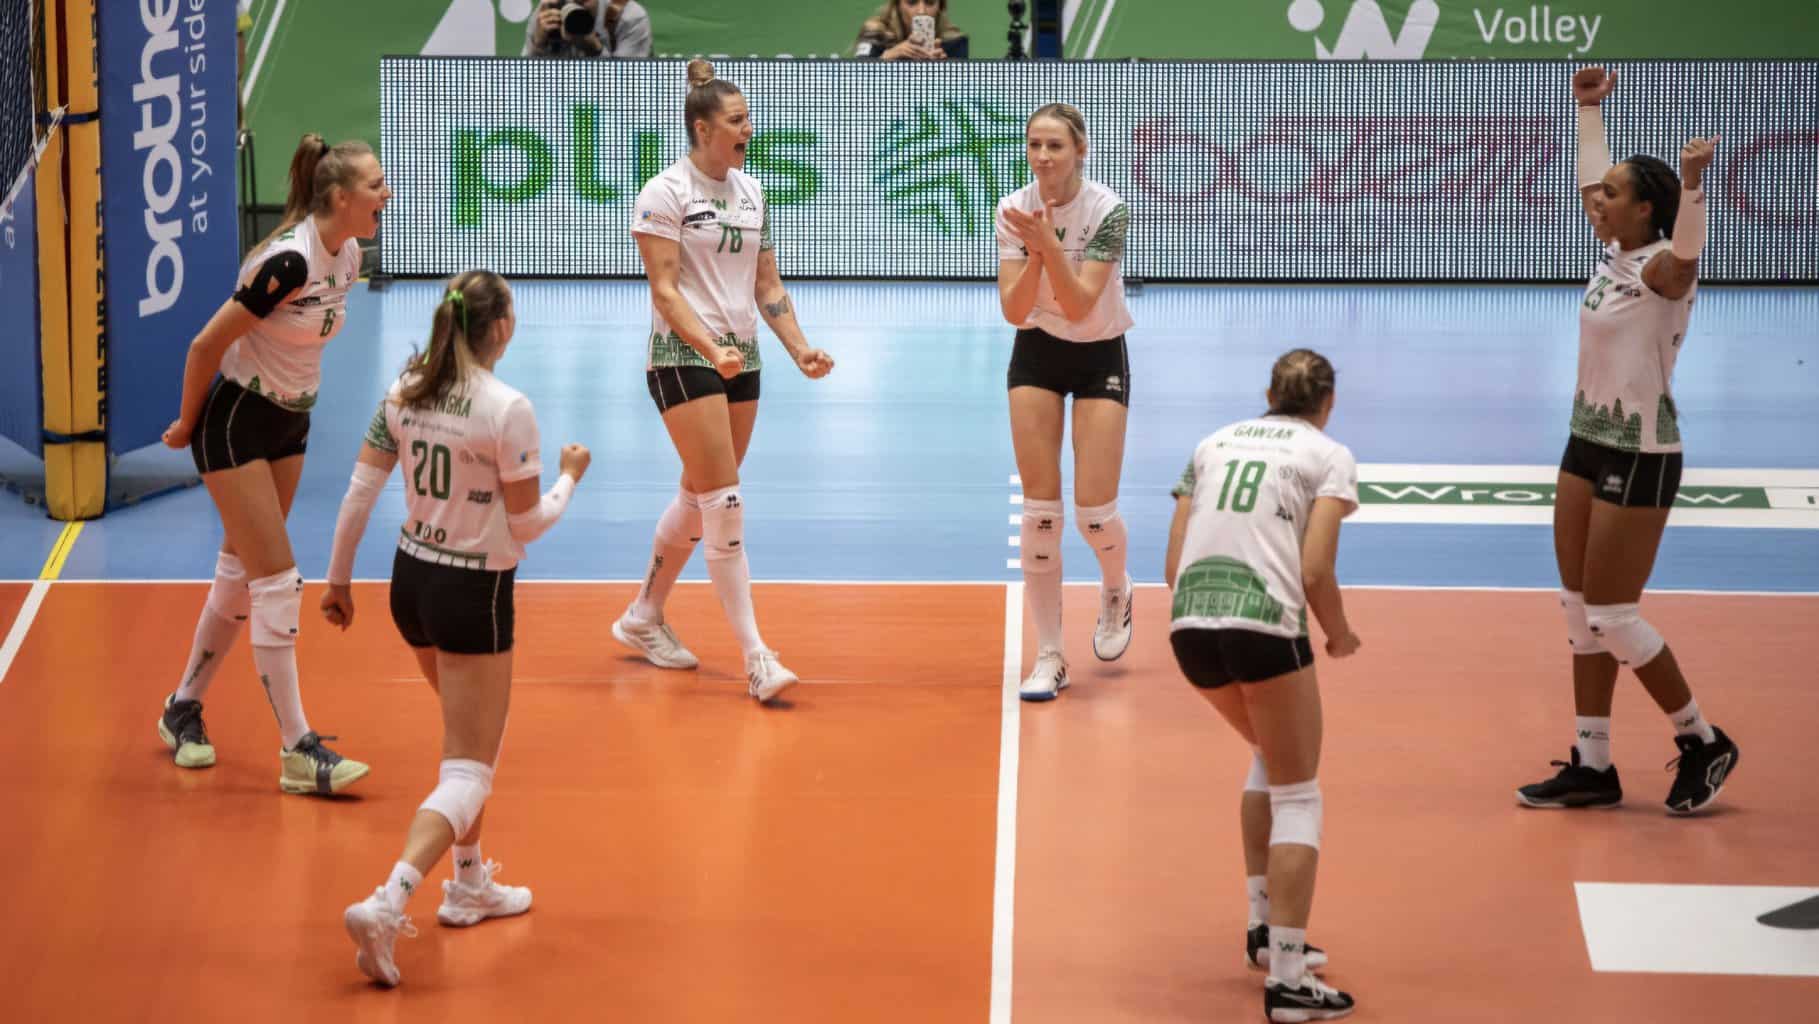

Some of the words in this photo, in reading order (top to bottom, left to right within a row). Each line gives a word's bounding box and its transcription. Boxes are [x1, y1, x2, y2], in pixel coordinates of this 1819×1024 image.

[1473, 5, 1602, 53] Volley
[189, 83, 213, 181] your
[188, 190, 209, 233] at
[716, 223, 743, 254] 78
[411, 439, 452, 500] 20
[1216, 459, 1267, 513] 18
